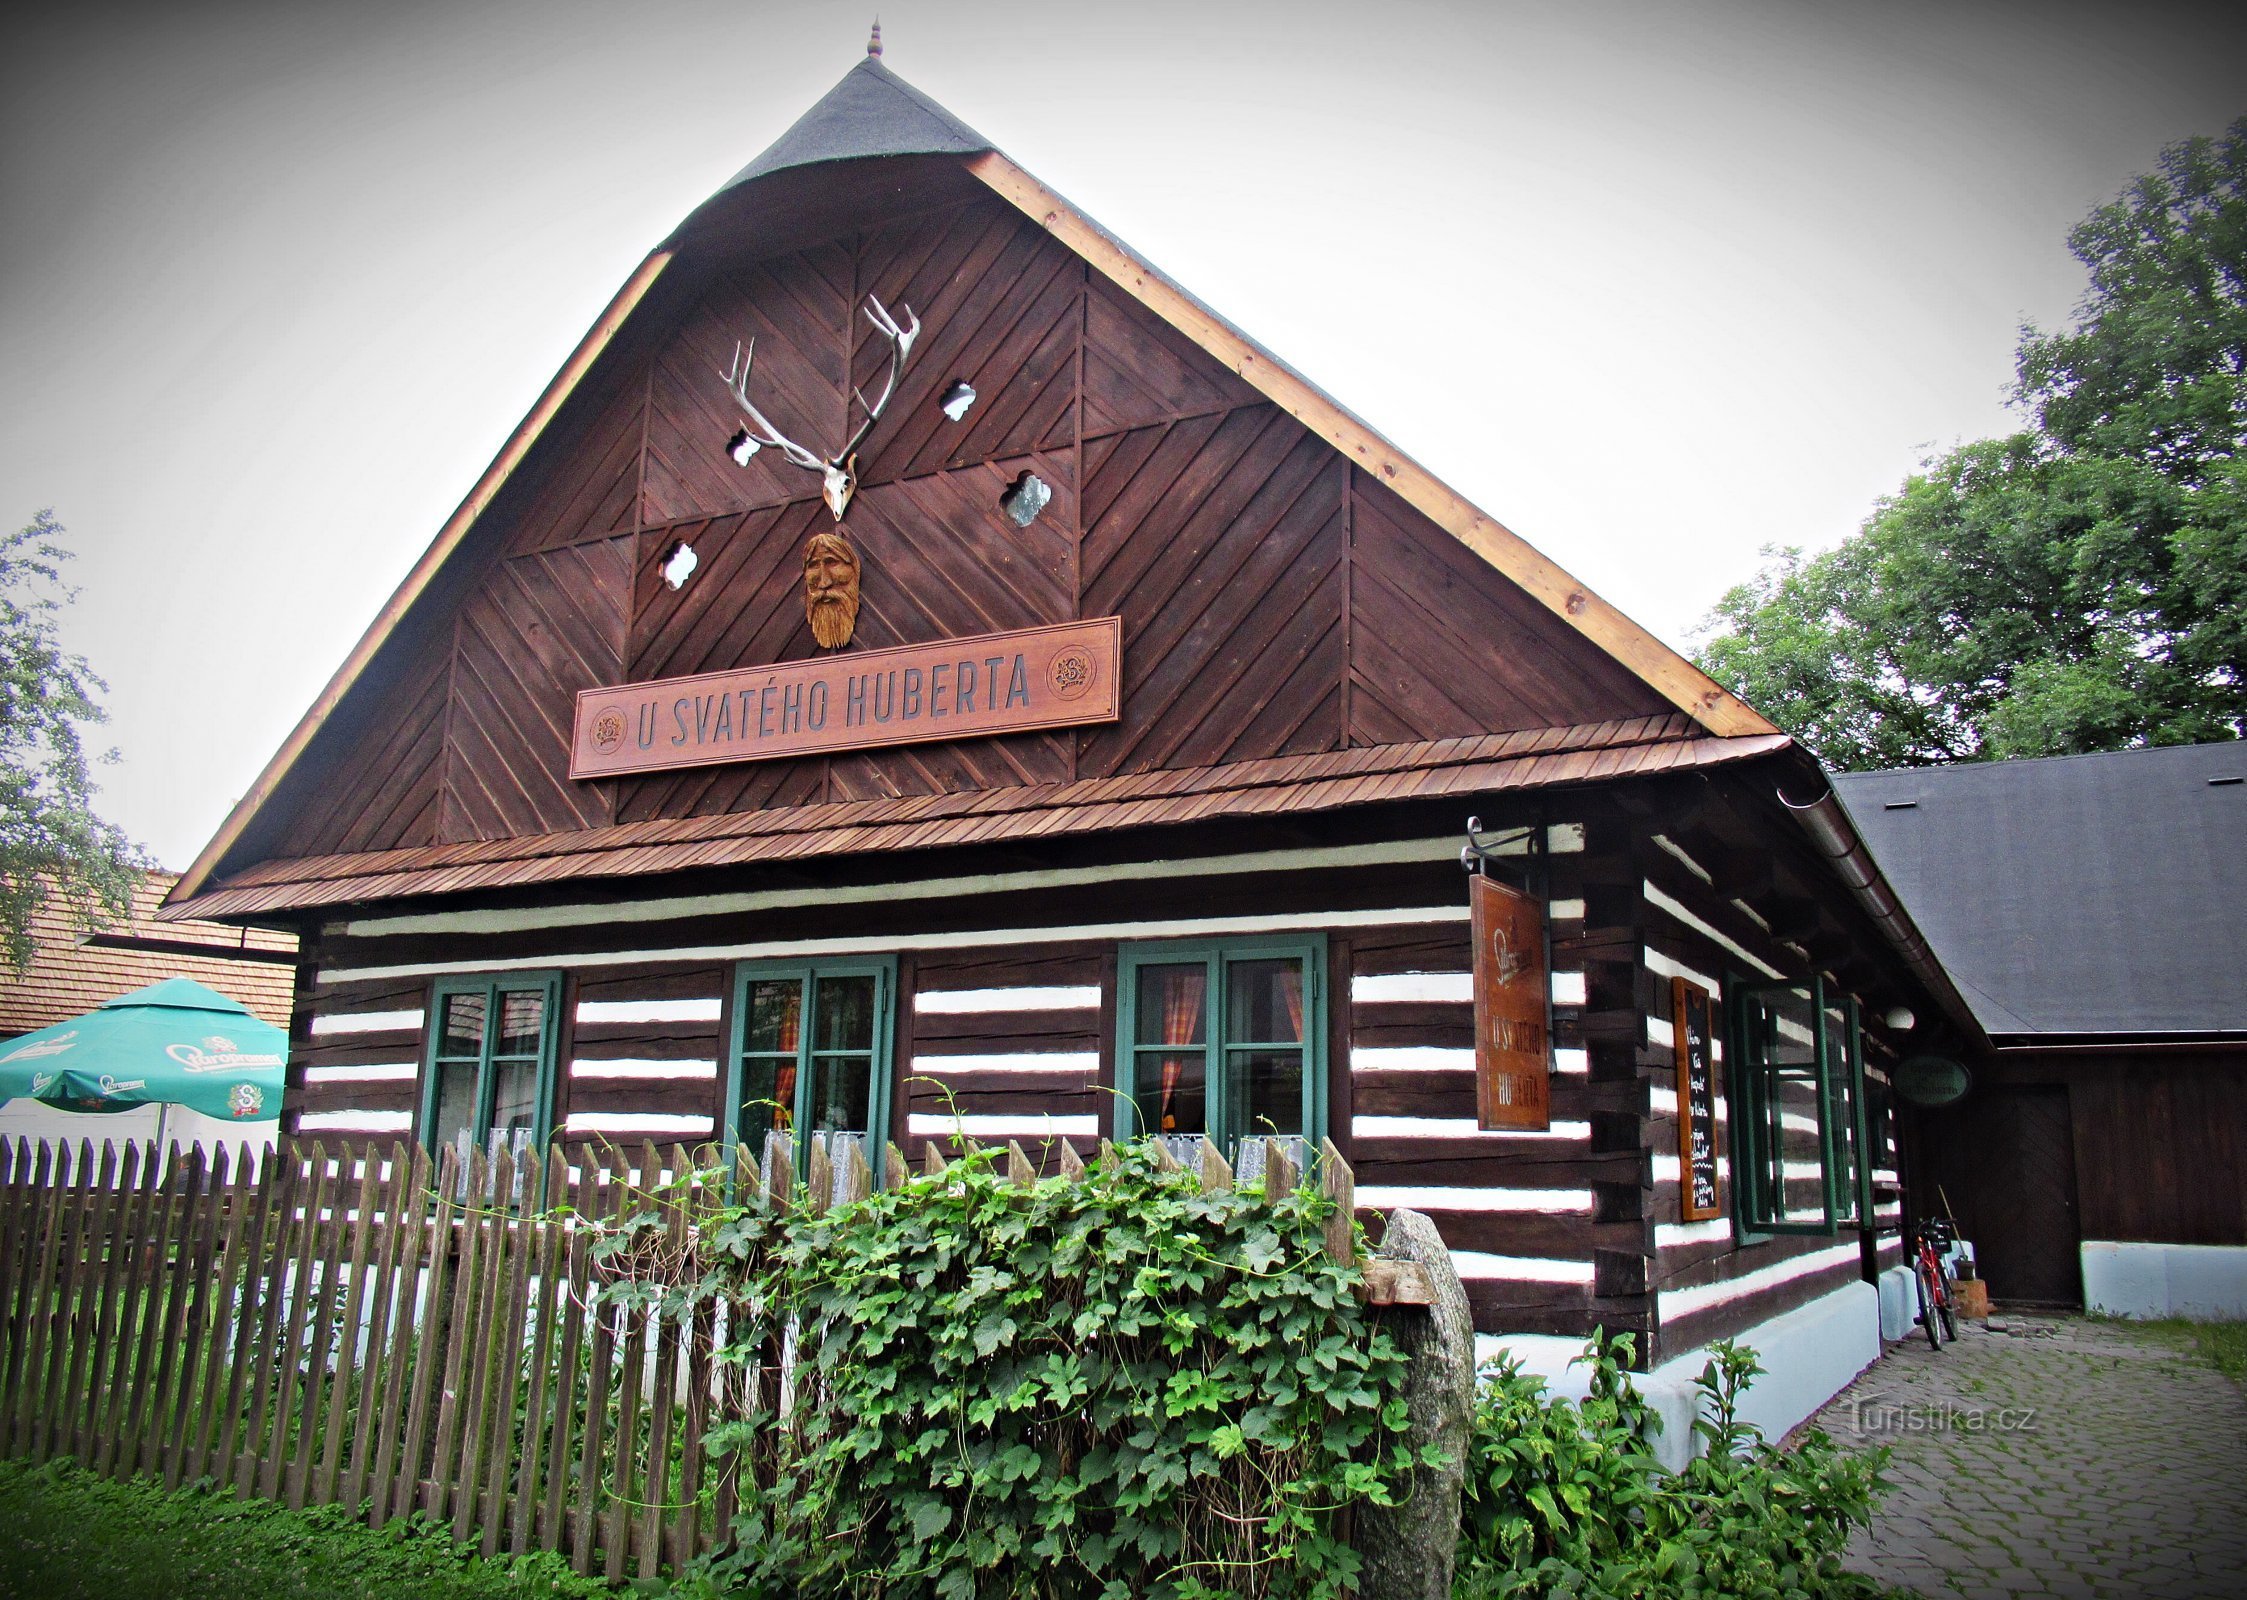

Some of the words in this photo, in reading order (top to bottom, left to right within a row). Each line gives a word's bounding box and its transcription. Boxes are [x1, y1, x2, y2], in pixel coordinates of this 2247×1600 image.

[638, 702, 658, 750] U
[671, 676, 830, 747] SVATÉHO
[846, 654, 1030, 728] HUBERTA
[166, 1044, 285, 1073] Staropramen
